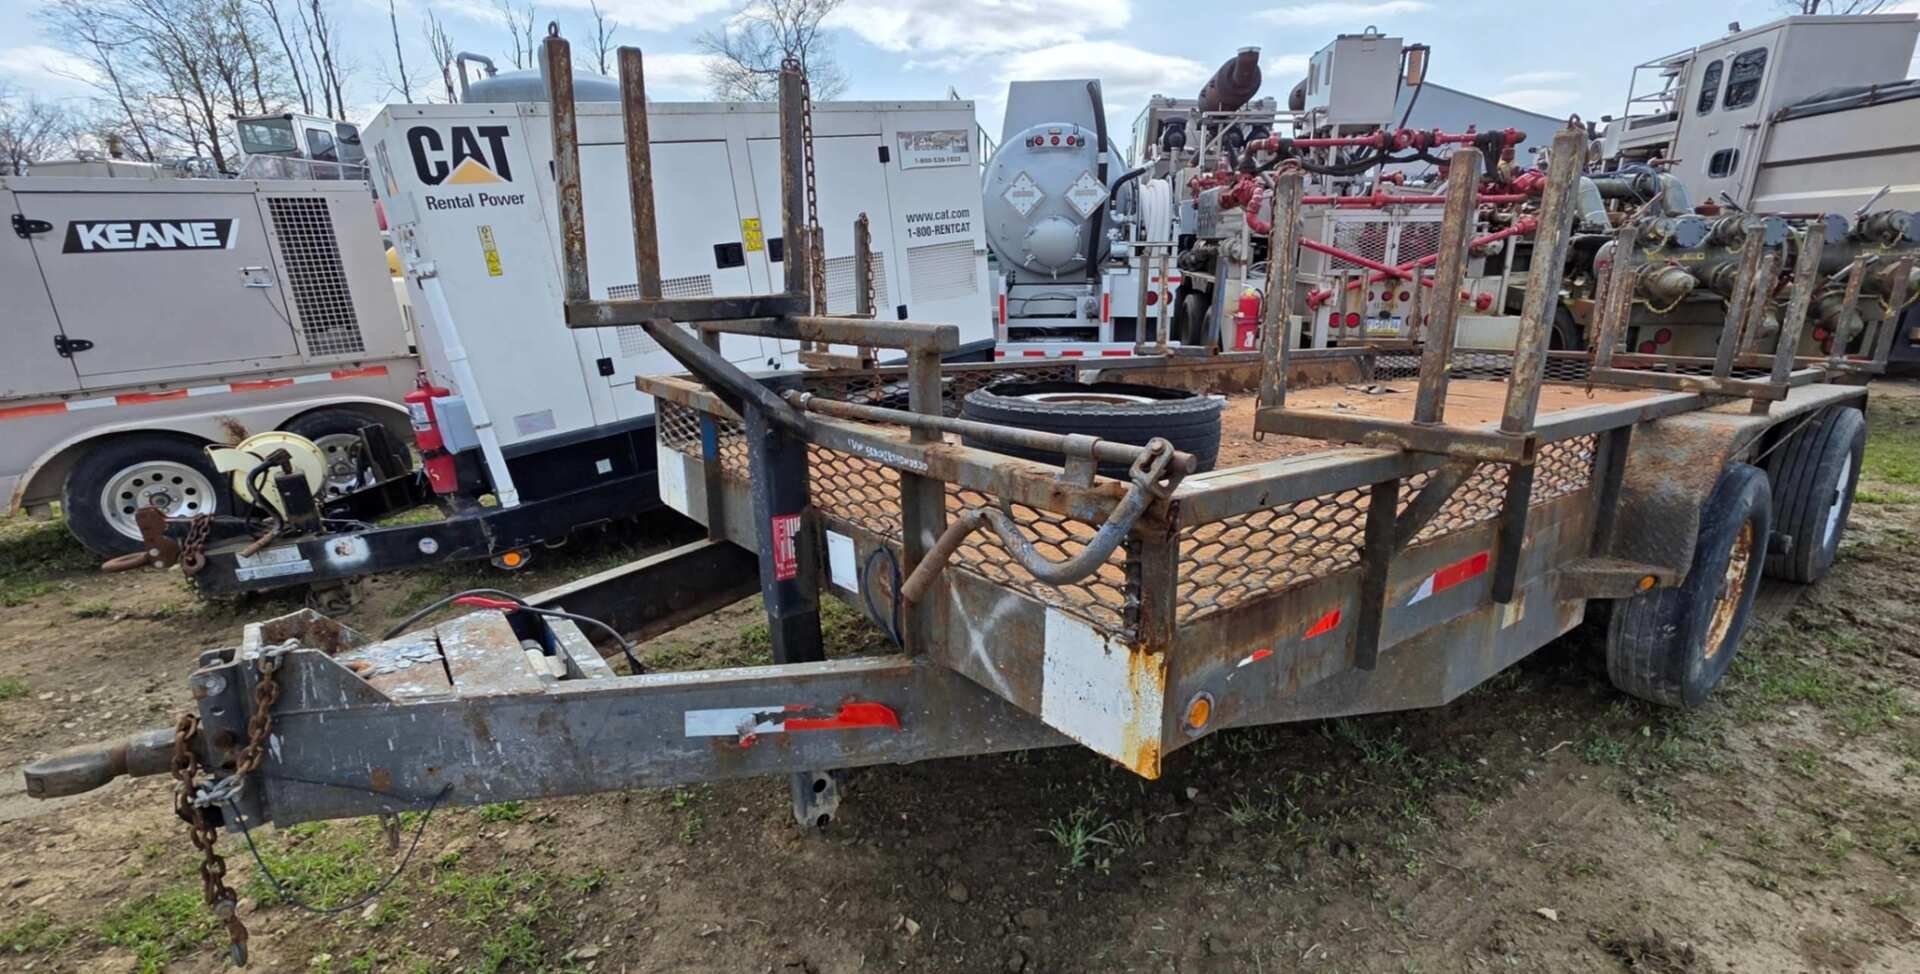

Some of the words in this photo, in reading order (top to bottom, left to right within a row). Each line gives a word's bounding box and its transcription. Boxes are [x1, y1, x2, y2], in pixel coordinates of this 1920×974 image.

[406, 125, 513, 186] CAT
[425, 193, 475, 211] Rental
[478, 192, 524, 207] Power
[906, 208, 970, 223] www.cat.com
[75, 222, 221, 250] KEANE
[907, 222, 971, 239] 1-800-RENTCAT
